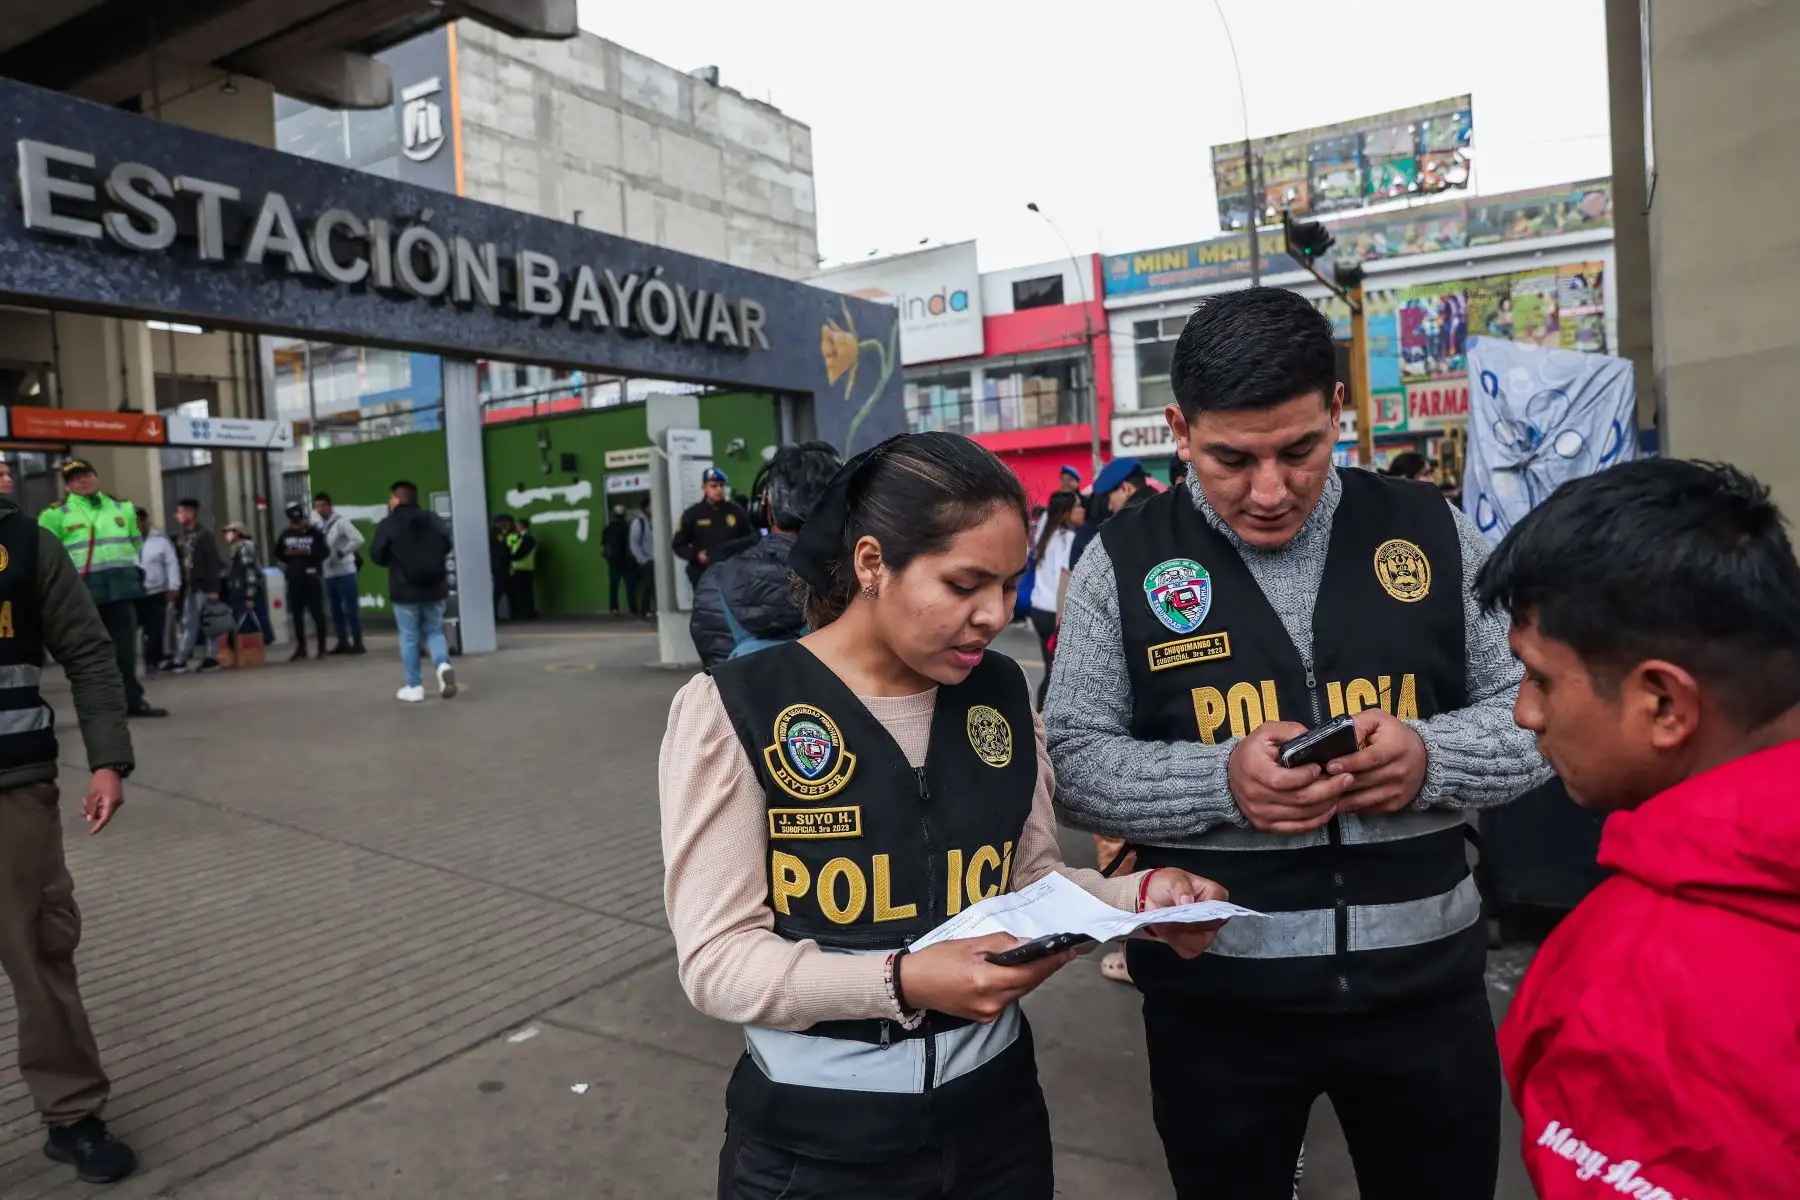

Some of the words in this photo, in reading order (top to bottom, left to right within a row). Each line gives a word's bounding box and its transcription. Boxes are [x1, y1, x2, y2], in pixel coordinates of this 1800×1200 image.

[17, 138, 501, 308] ESTACIÓN
[515, 249, 770, 350] BAYÓVAR
[1134, 250, 1189, 275] MINI
[1119, 426, 1175, 448] CHIF
[776, 767, 845, 795] DIVSEFER
[778, 814, 791, 825] J.
[795, 813, 833, 825] SUYO
[838, 811, 852, 823] H.
[781, 825, 817, 834] SUBOFICIAL
[832, 824, 850, 832] 2023
